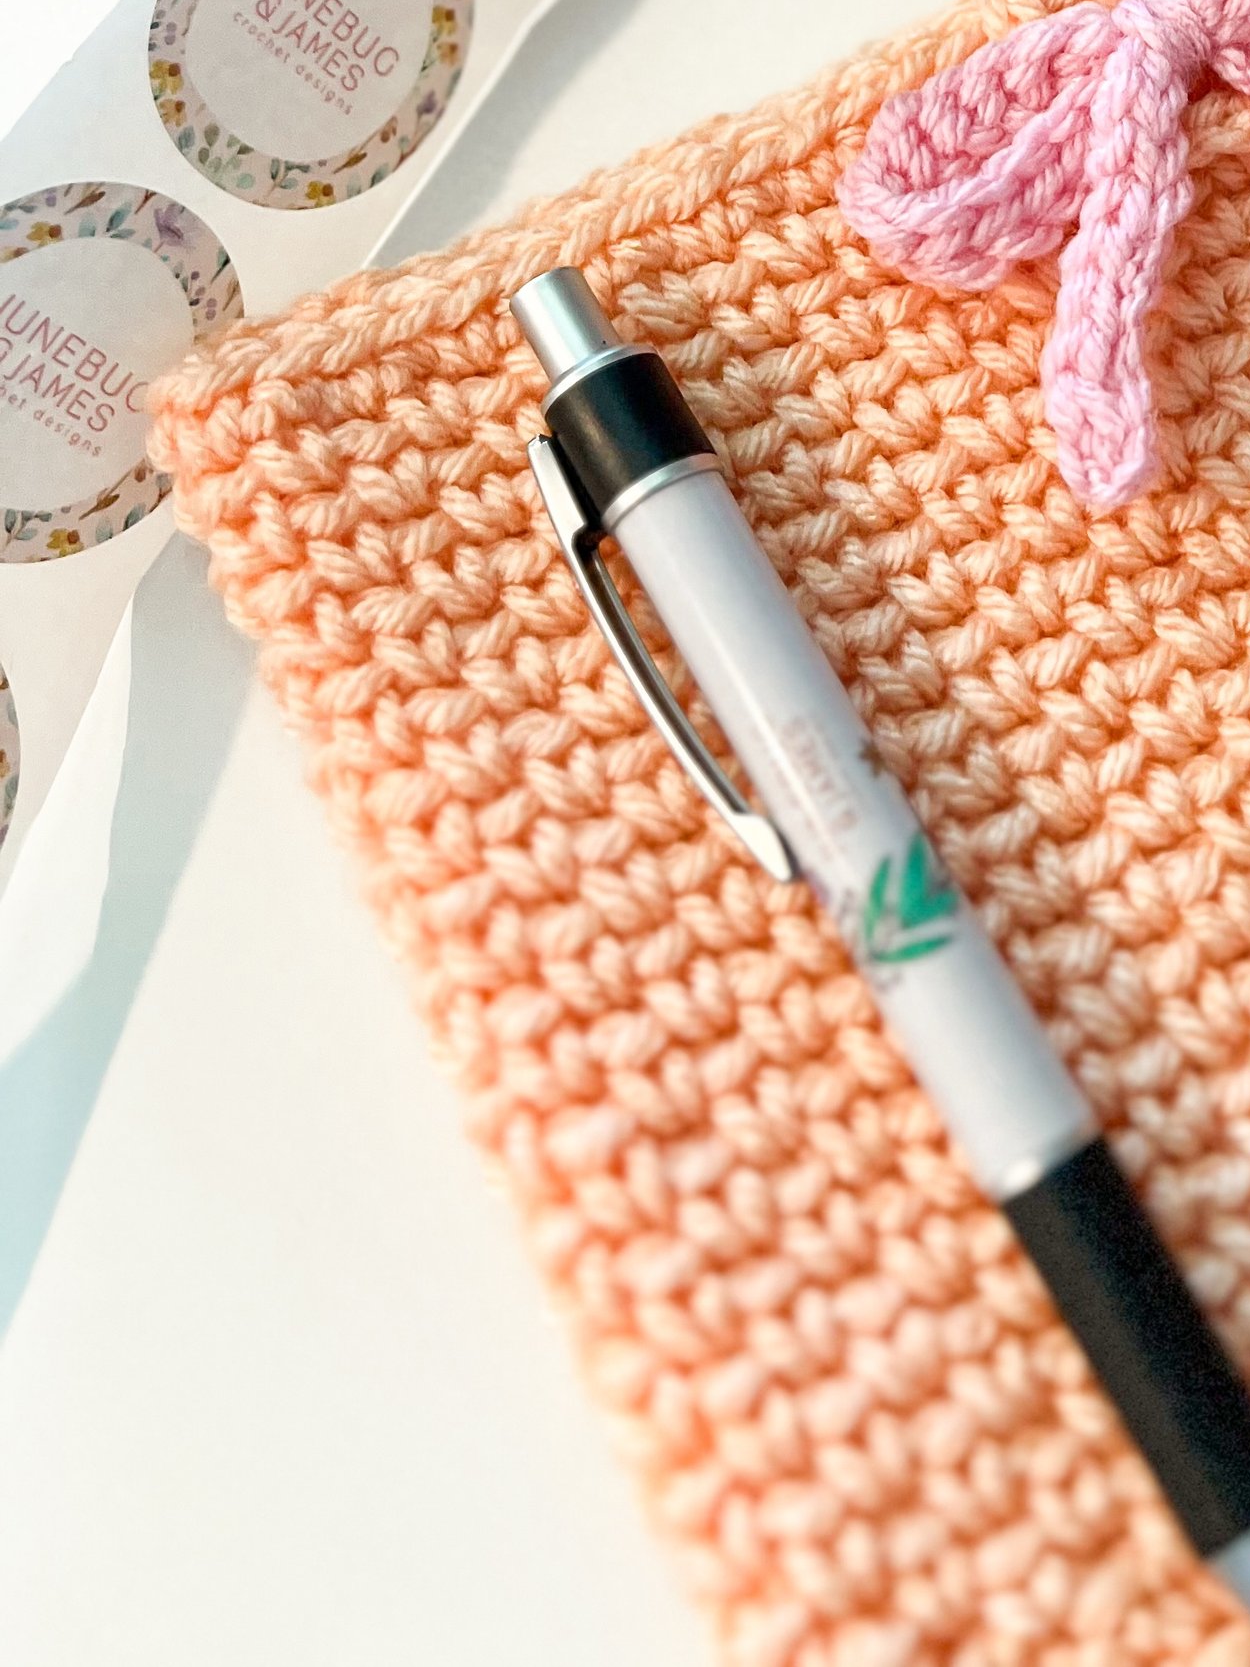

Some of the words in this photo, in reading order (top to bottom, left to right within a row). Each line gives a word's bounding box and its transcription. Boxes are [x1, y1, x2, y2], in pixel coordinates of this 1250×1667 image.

[233, 12, 291, 63] crochet
[295, 64, 353, 116] designs
[272, 10, 365, 92] JAMES
[3, 354, 115, 433] JAMES
[33, 409, 102, 457] designs
